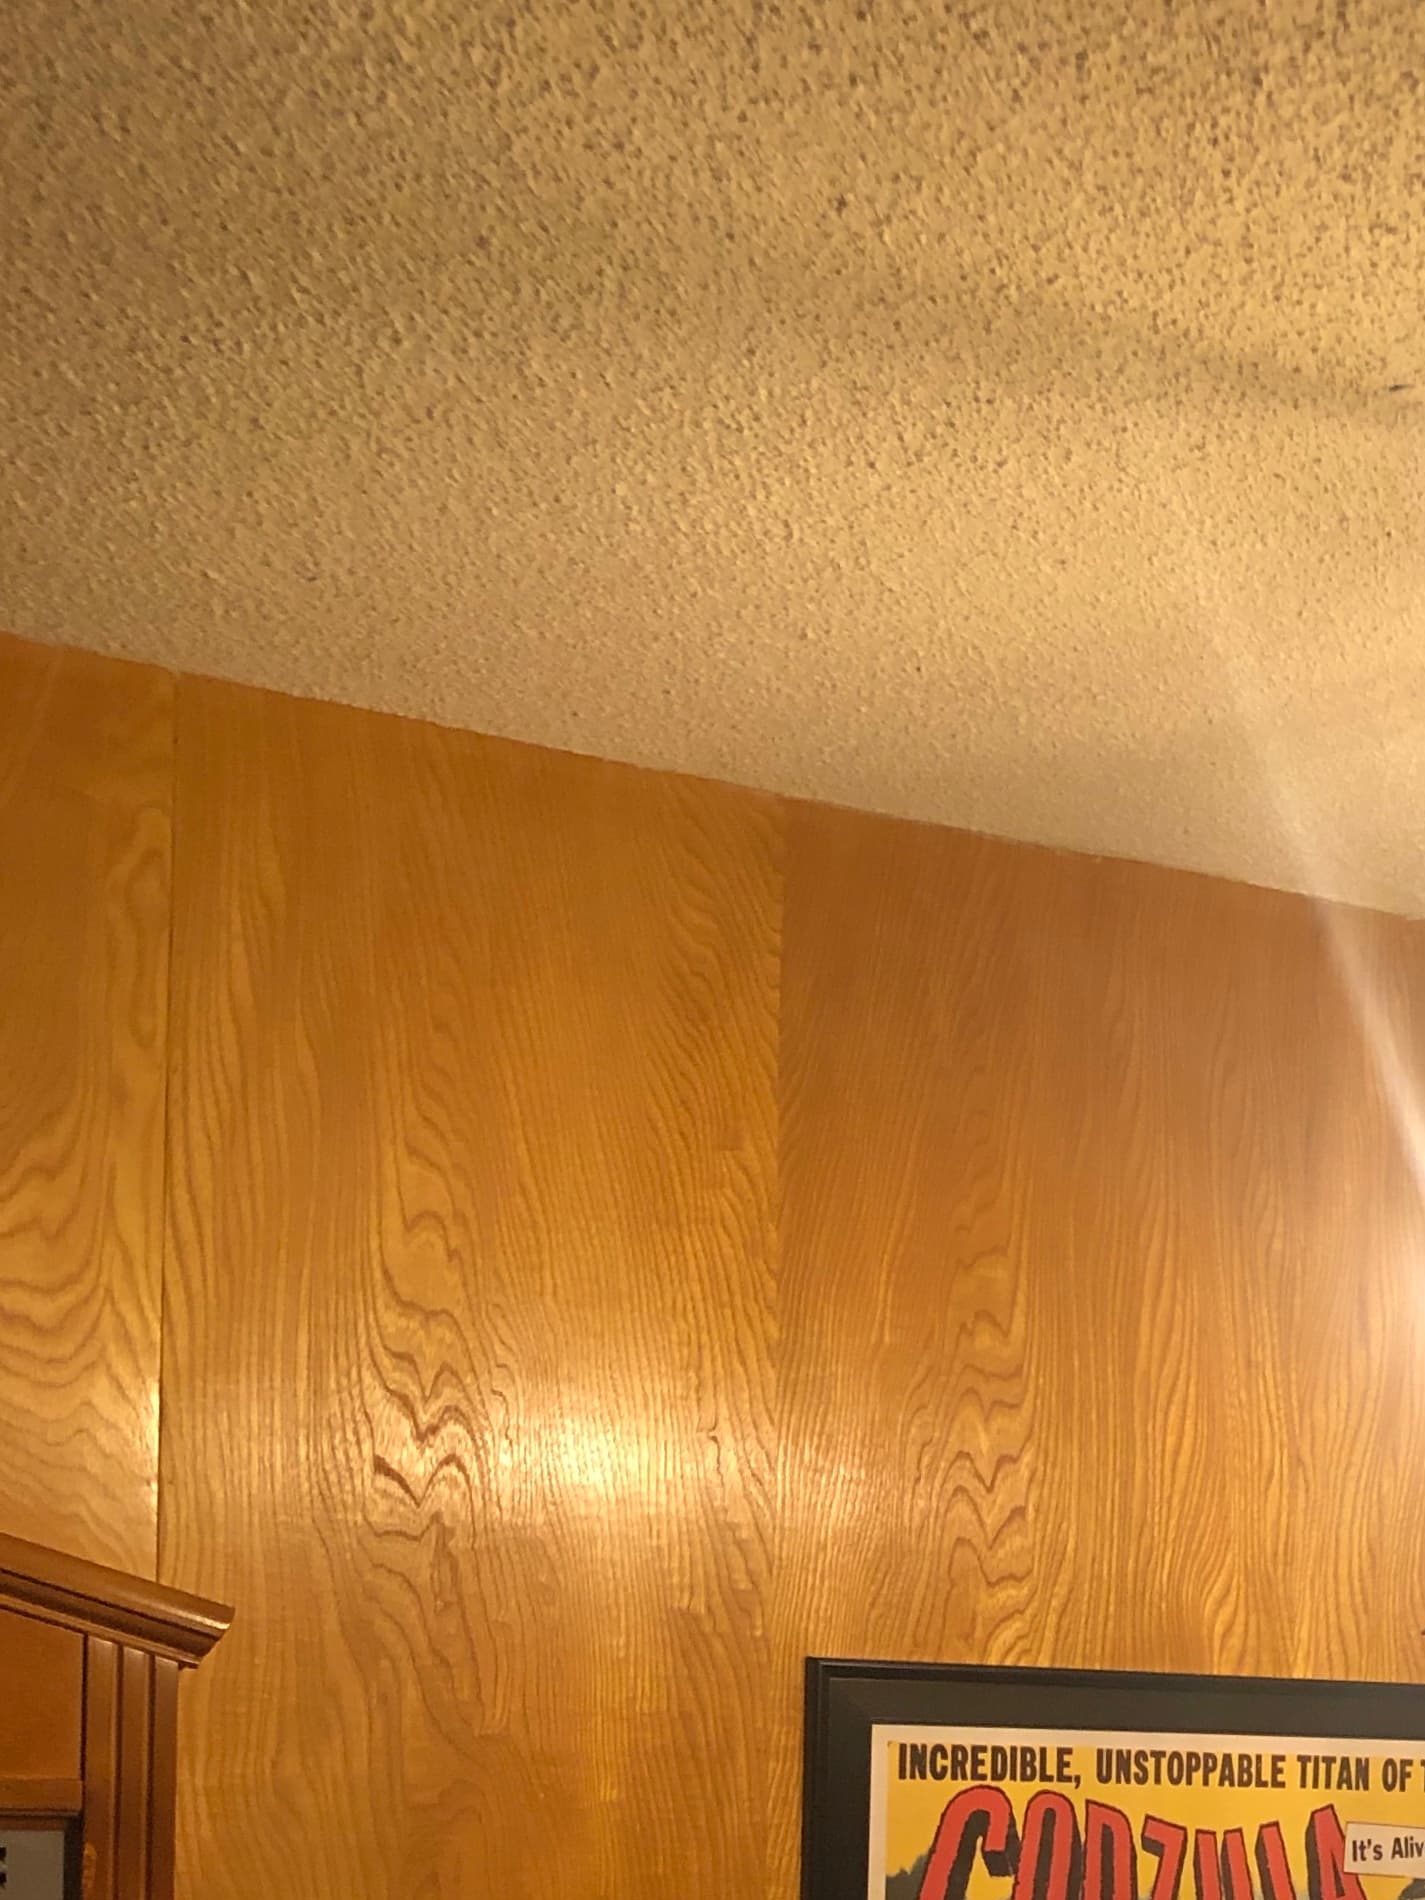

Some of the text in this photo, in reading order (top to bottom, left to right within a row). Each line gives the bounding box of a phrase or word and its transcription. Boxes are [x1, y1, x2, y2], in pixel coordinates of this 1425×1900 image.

[898, 1743, 1081, 1789] INCREDIBLE,
[1096, 1748, 1285, 1788] UNSTOPPABLE
[1297, 1754, 1370, 1792] TITAN
[1382, 1757, 1415, 1793] OF
[1352, 1838, 1383, 1862] It's
